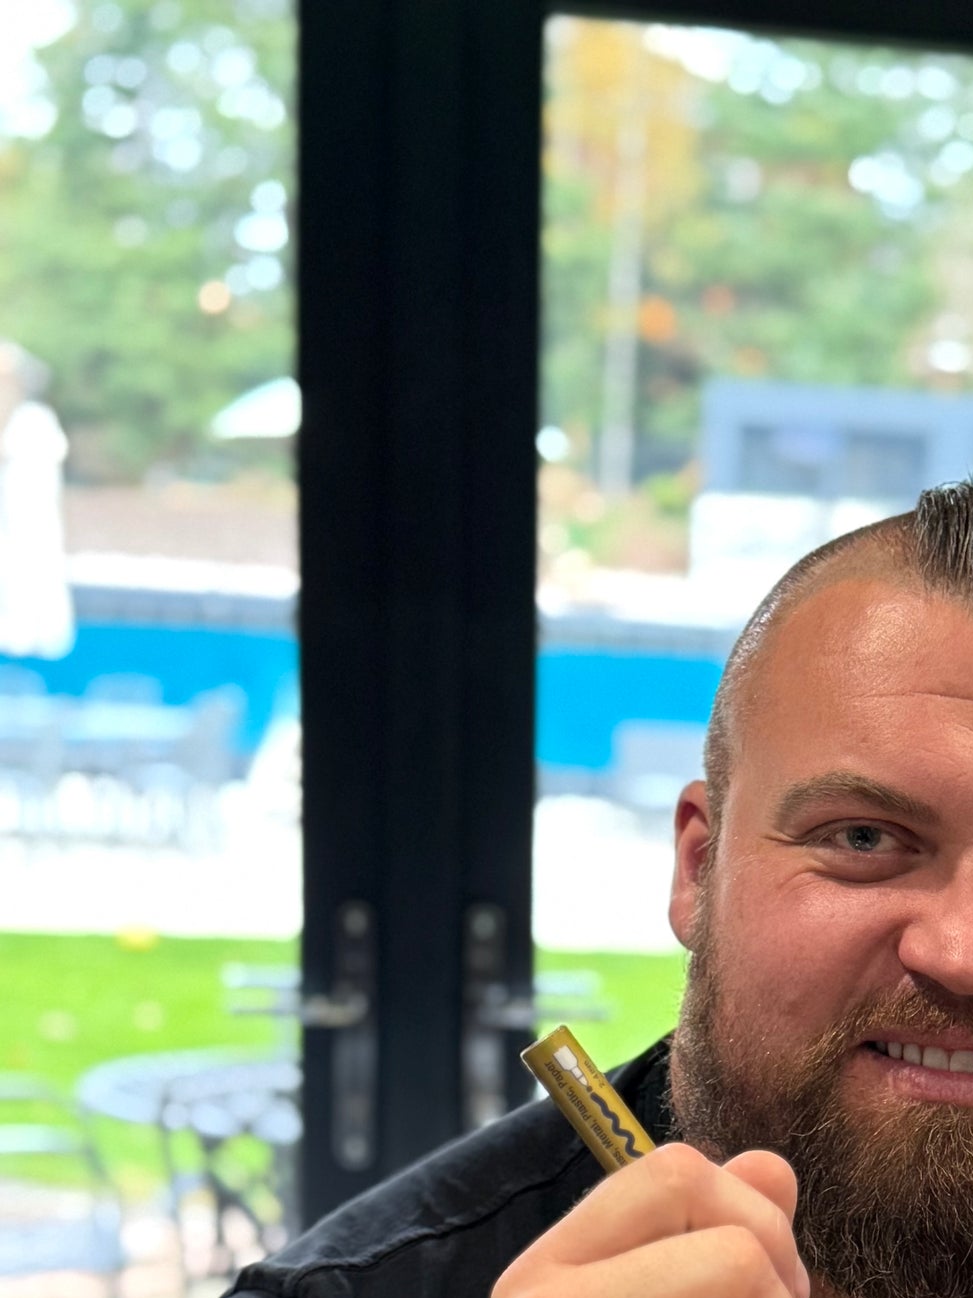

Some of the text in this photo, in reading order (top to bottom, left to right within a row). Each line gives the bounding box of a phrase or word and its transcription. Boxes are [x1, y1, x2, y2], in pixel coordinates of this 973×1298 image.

[543, 1060, 567, 1090] Paper
[566, 1086, 589, 1122] Plastic,
[590, 1118, 614, 1150] Metal,
